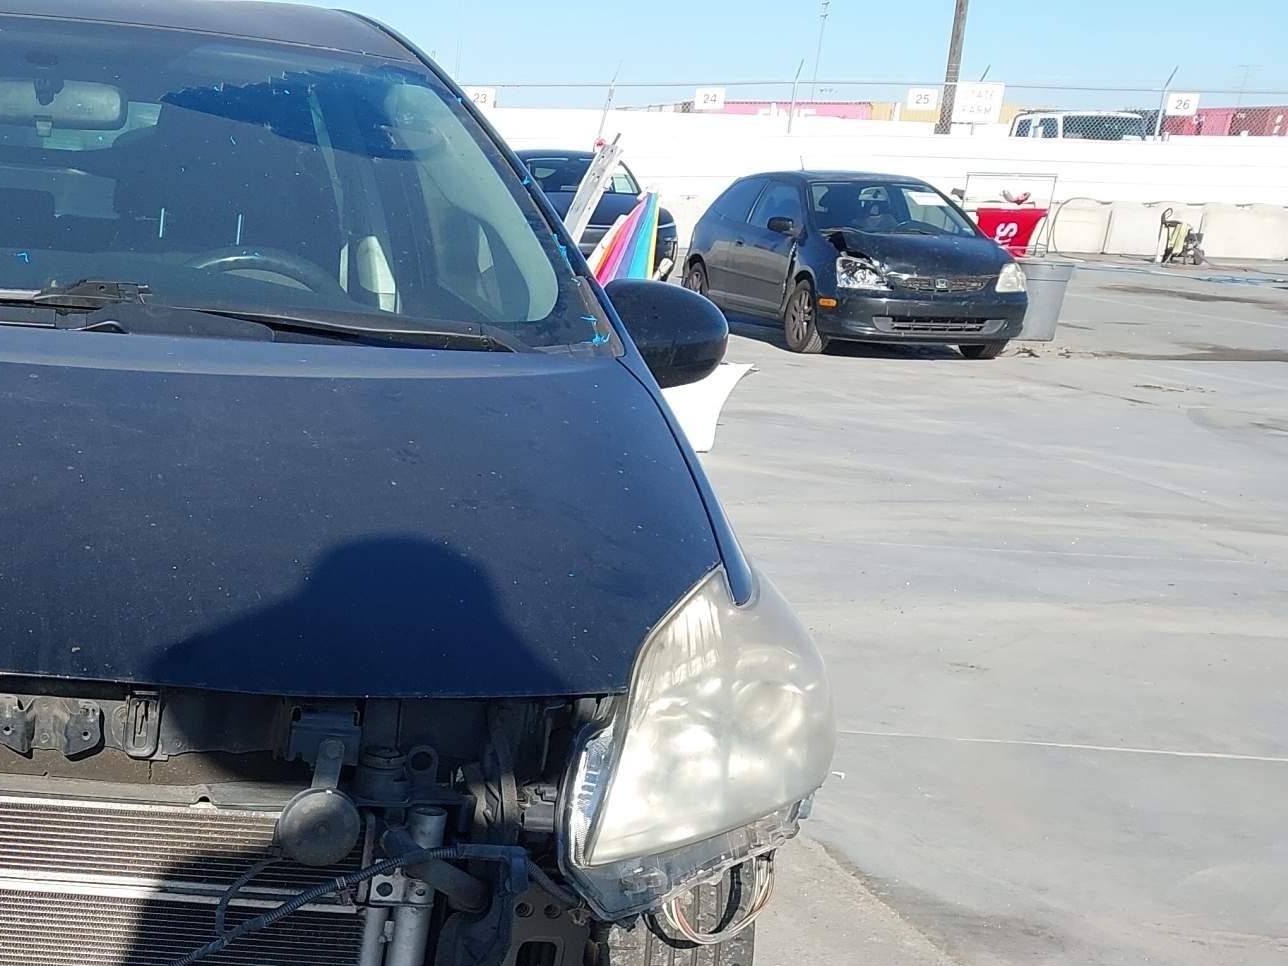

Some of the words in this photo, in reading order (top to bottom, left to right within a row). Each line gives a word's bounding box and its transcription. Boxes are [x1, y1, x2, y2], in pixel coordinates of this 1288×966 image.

[473, 92, 488, 104] 23
[703, 93, 717, 104] 24
[915, 94, 931, 105] 25
[1175, 99, 1191, 111] 26
